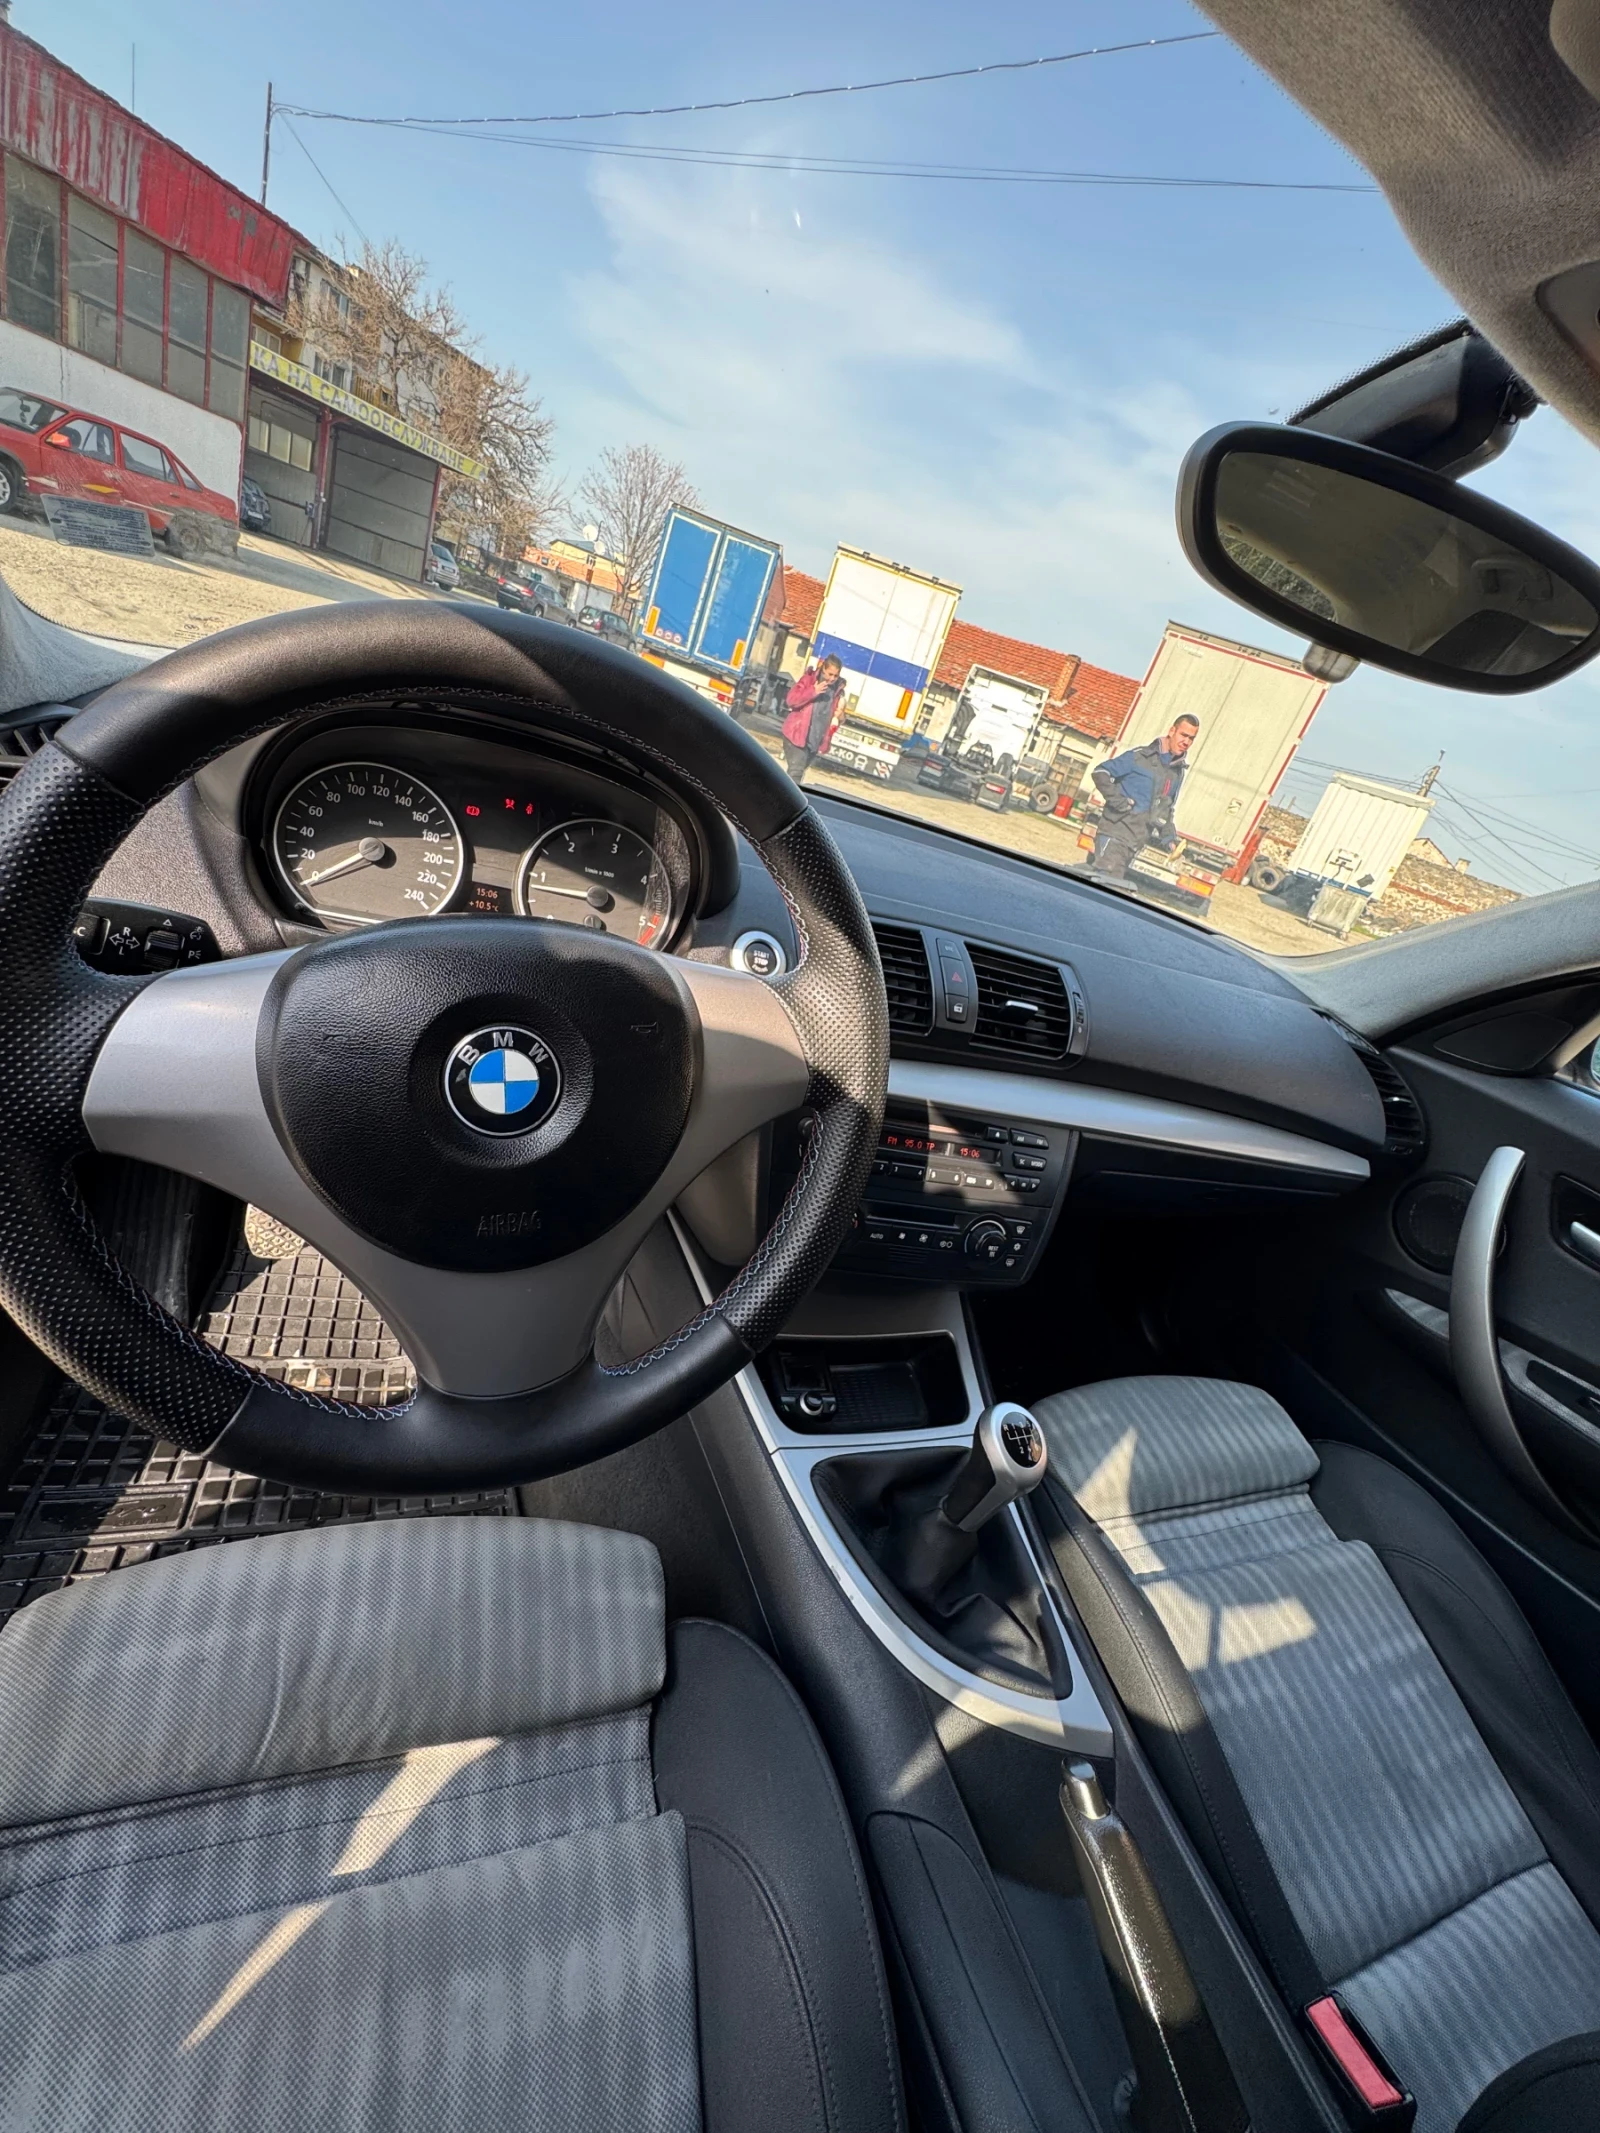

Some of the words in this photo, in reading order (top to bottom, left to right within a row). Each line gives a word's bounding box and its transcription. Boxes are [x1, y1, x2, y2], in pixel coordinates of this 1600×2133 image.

[287, 366, 313, 392] НА
[347, 784, 366, 796] 100
[372, 785, 390, 797] 120
[326, 792, 341, 803] 80
[394, 794, 412, 807] 140
[308, 806, 323, 818] 60
[412, 811, 429, 823] 160
[300, 827, 315, 838] 40
[422, 829, 440, 843] 180
[568, 842, 576, 853] 2
[611, 843, 618, 854] 3
[301, 848, 315, 860] 20
[423, 852, 442, 865] 200
[417, 871, 437, 884] 220
[540, 872, 546, 882] 1
[640, 875, 648, 885] 4
[404, 889, 424, 901] 240
[476, 888, 498, 899] 15:06
[638, 916, 647, 927] 5
[123, 927, 131, 936] R
[119, 946, 125, 955] L
[457, 1031, 549, 1066] BMW
[887, 1136, 897, 1146] FM
[904, 1139, 923, 1149] 95.0
[926, 1142, 935, 1150] TP
[960, 1147, 980, 1158] 15:06
[477, 1210, 542, 1238] AIRBAG
